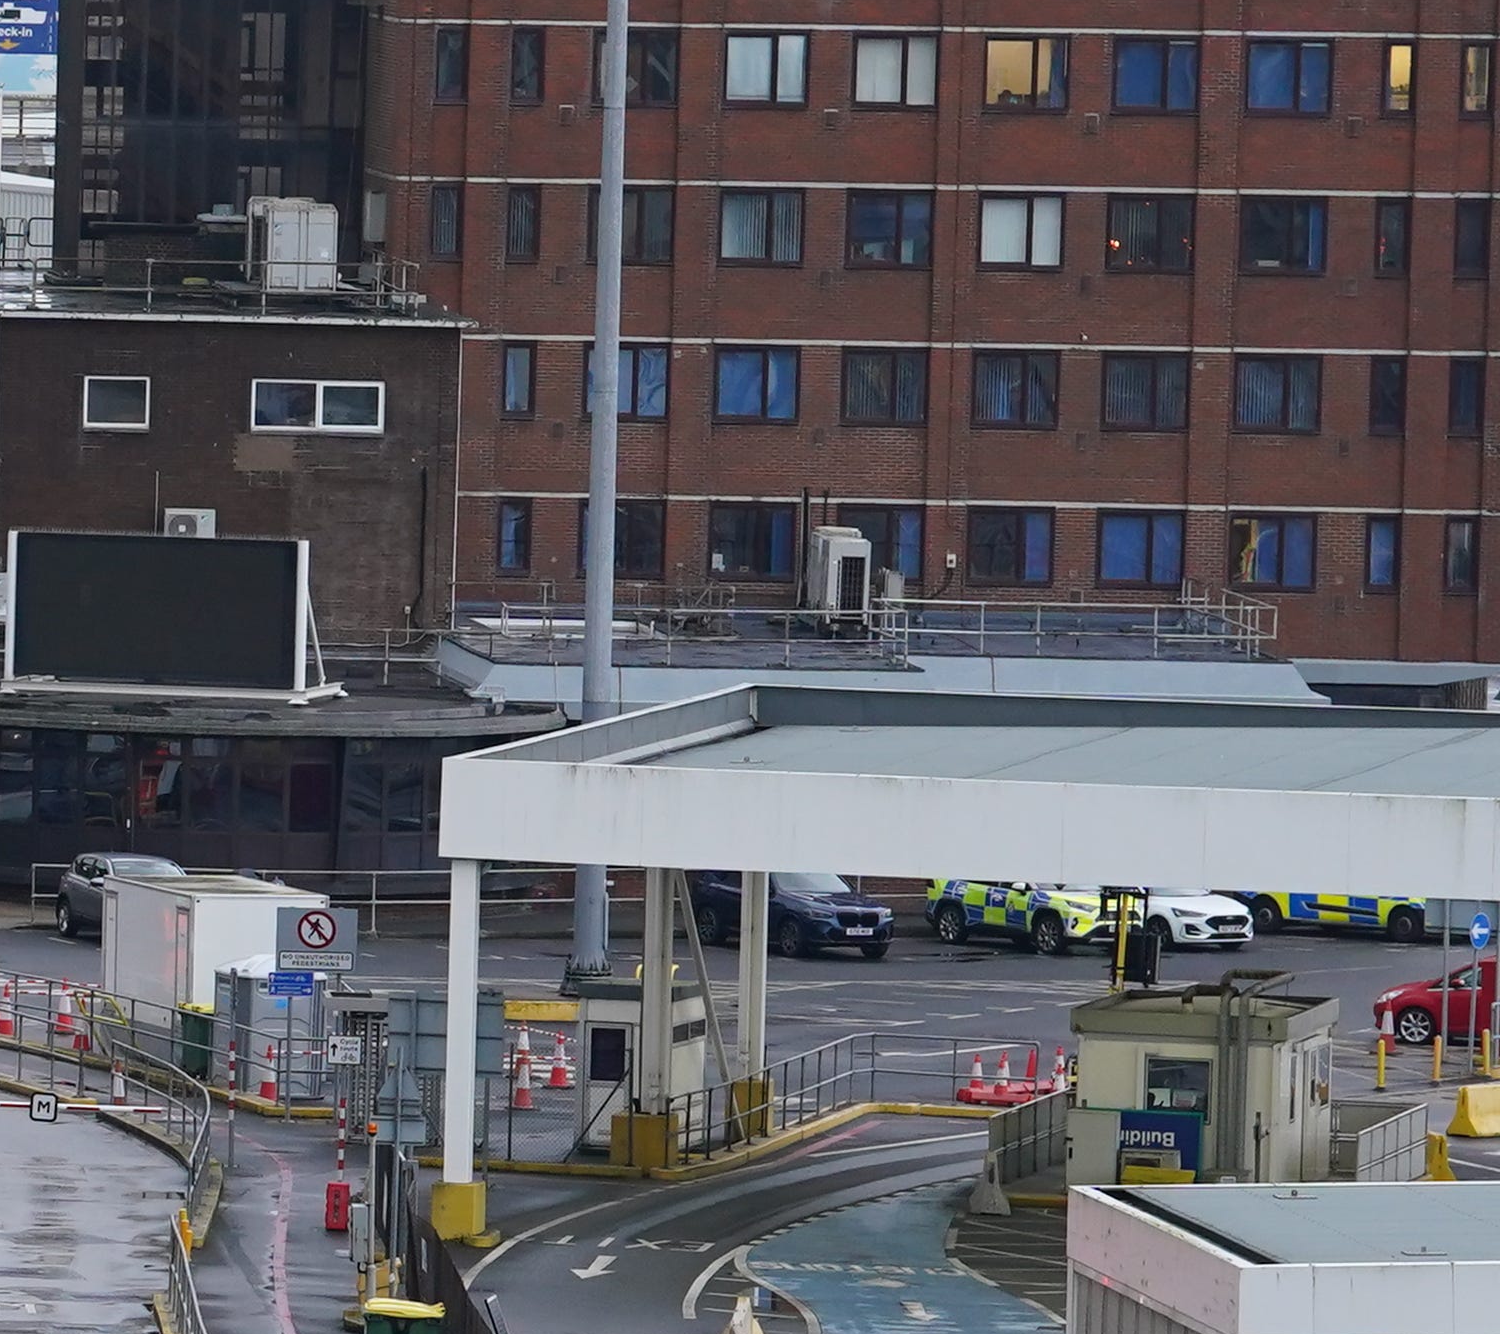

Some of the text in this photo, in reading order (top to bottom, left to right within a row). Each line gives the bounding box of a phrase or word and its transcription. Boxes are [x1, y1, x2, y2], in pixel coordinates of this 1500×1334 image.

[293, 953, 350, 962] UNAUTHORISED
[291, 960, 340, 968] PEDESTRIANS
[36, 1099, 51, 1114] M
